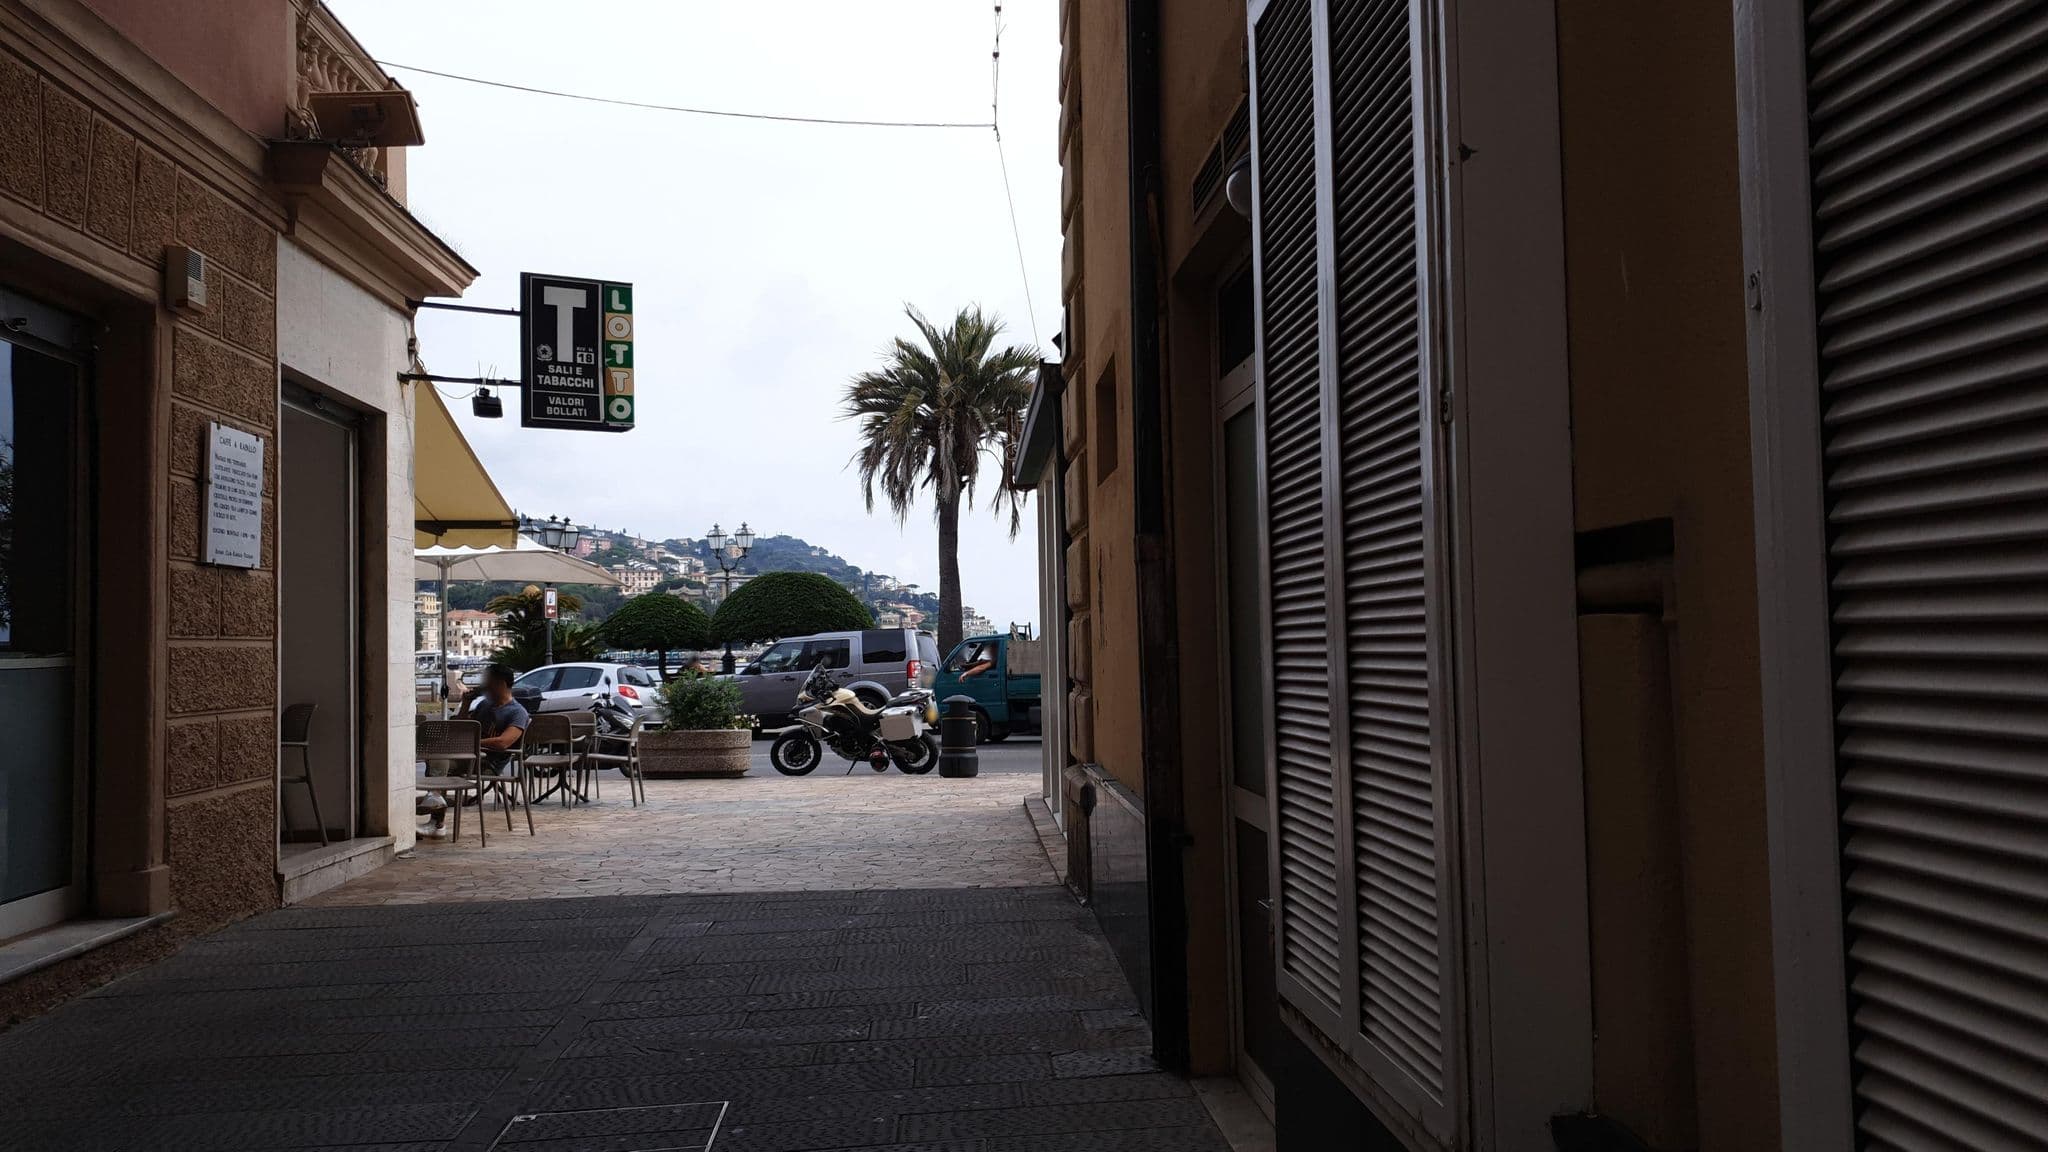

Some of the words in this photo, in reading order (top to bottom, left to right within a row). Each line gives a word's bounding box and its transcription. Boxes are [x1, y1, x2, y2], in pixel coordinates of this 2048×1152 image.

[543, 285, 587, 363] T
[577, 353, 593, 364] 18
[607, 289, 632, 420] LOTTO
[548, 364, 573, 375] SALI
[575, 366, 583, 375] E
[537, 374, 594, 389] TABACCHI
[548, 396, 585, 407] VALORI
[546, 406, 587, 417] BOLLATI
